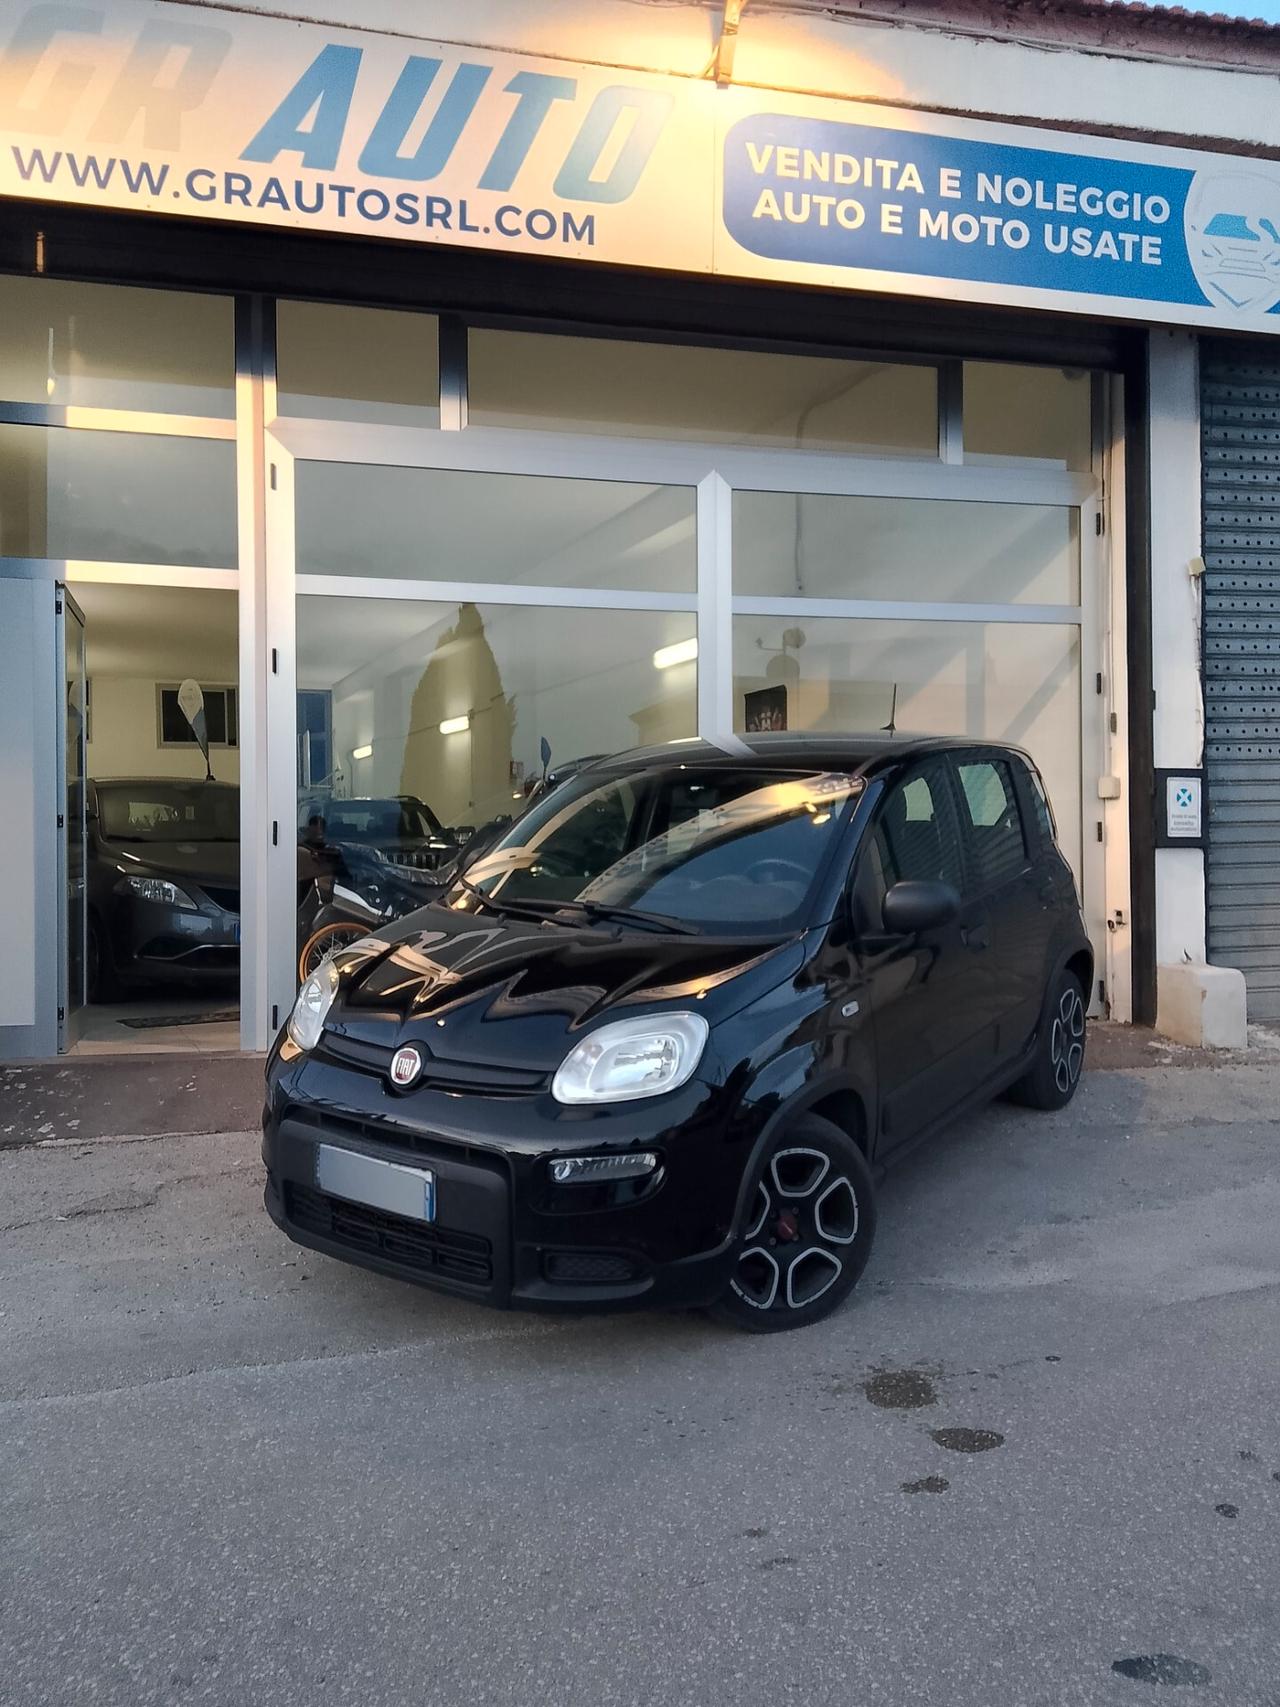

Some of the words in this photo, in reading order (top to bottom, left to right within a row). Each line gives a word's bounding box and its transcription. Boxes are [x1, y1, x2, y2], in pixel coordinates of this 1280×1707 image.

[0, 3, 233, 152] GR
[238, 43, 676, 205] AUTO
[11, 145, 596, 246] WWW.GRAUTOSRL.COM
[746, 143, 925, 194] VENDITA
[939, 168, 962, 198] E
[977, 173, 1171, 225] NOLEGGIO
[752, 189, 866, 230] AUTO
[880, 204, 903, 235] E
[919, 208, 1030, 250] MOTO
[1043, 224, 1163, 266] USATE
[397, 1058, 415, 1076] FIAT
